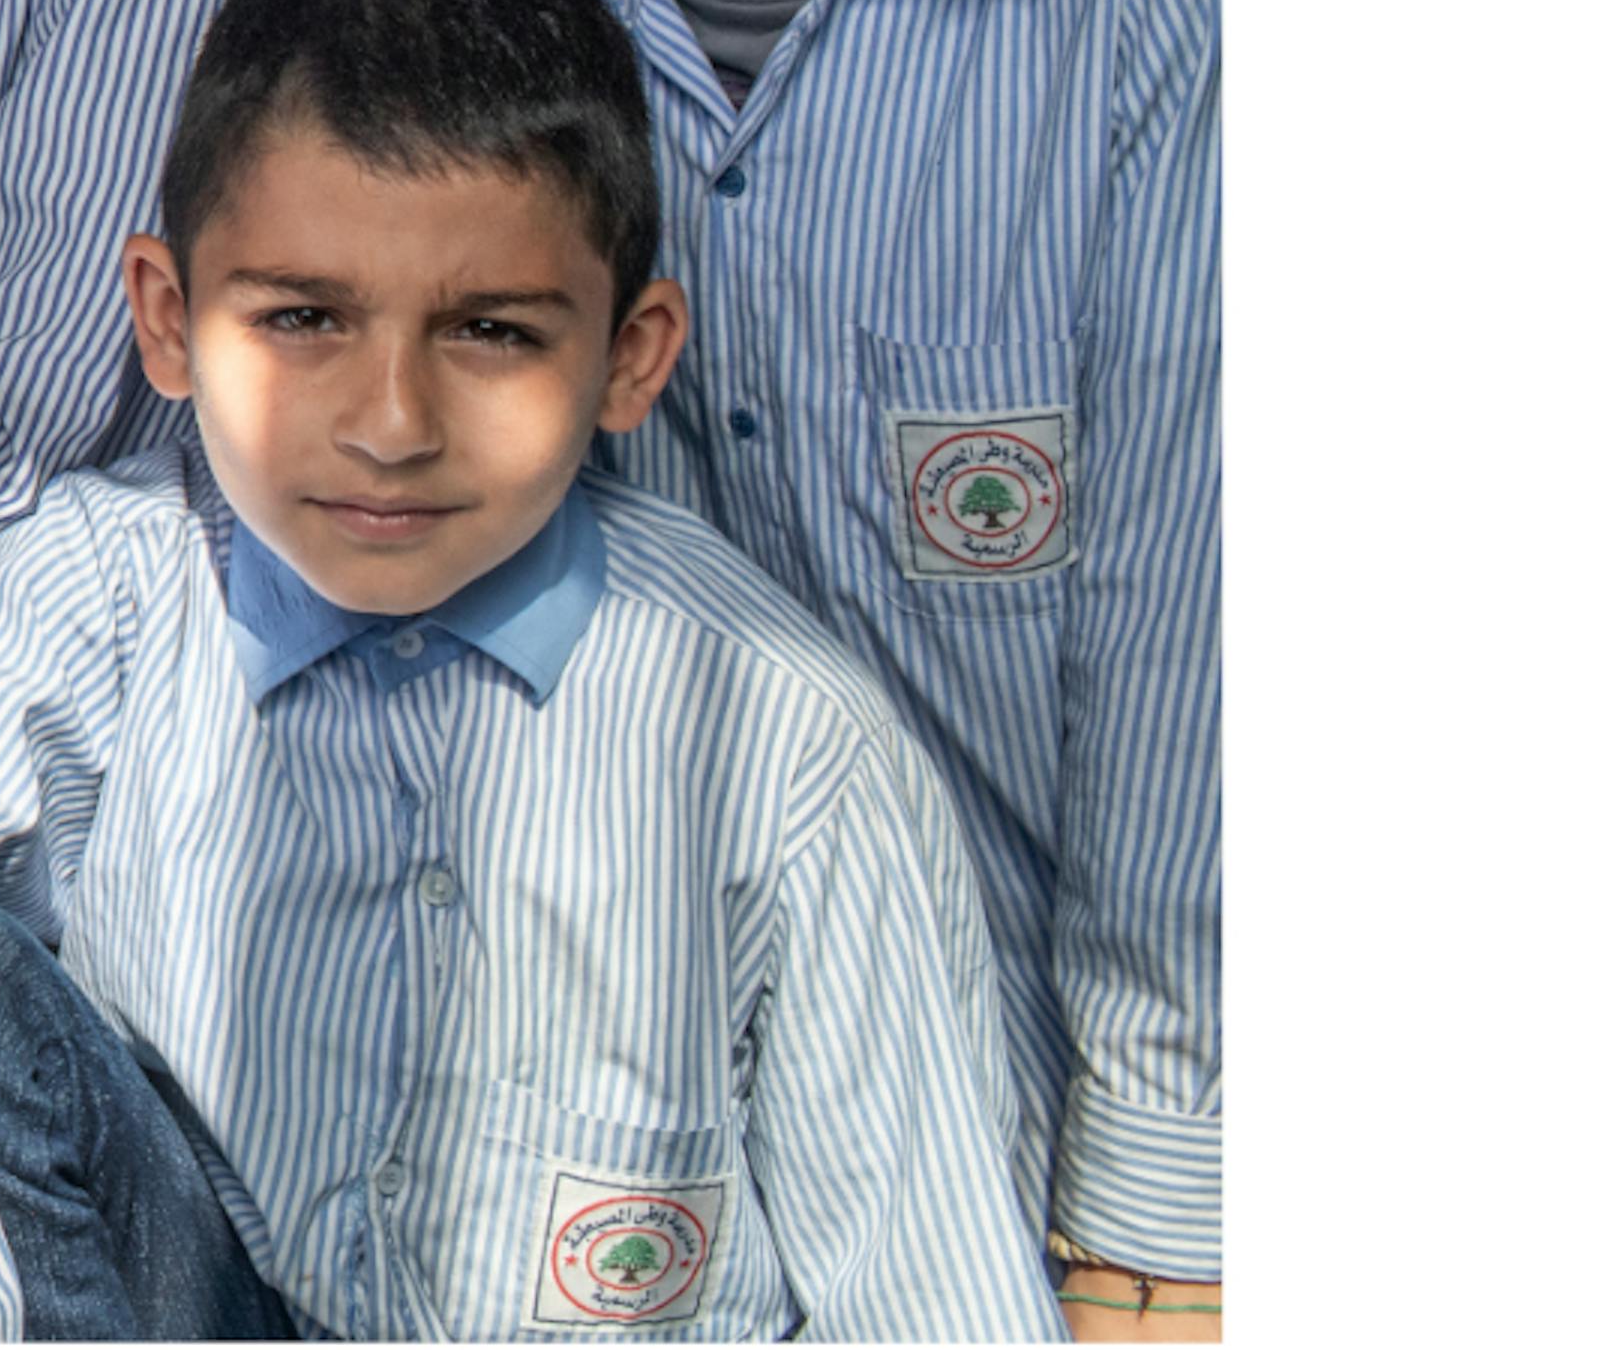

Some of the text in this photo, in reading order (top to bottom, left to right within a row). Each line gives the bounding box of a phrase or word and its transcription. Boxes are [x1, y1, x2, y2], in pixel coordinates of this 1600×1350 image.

[1011, 446, 1049, 489] مدرسة
[960, 529, 1031, 560] الرسمية
[666, 1210, 697, 1254] مدرسة
[591, 1284, 660, 1313] الرسمية
